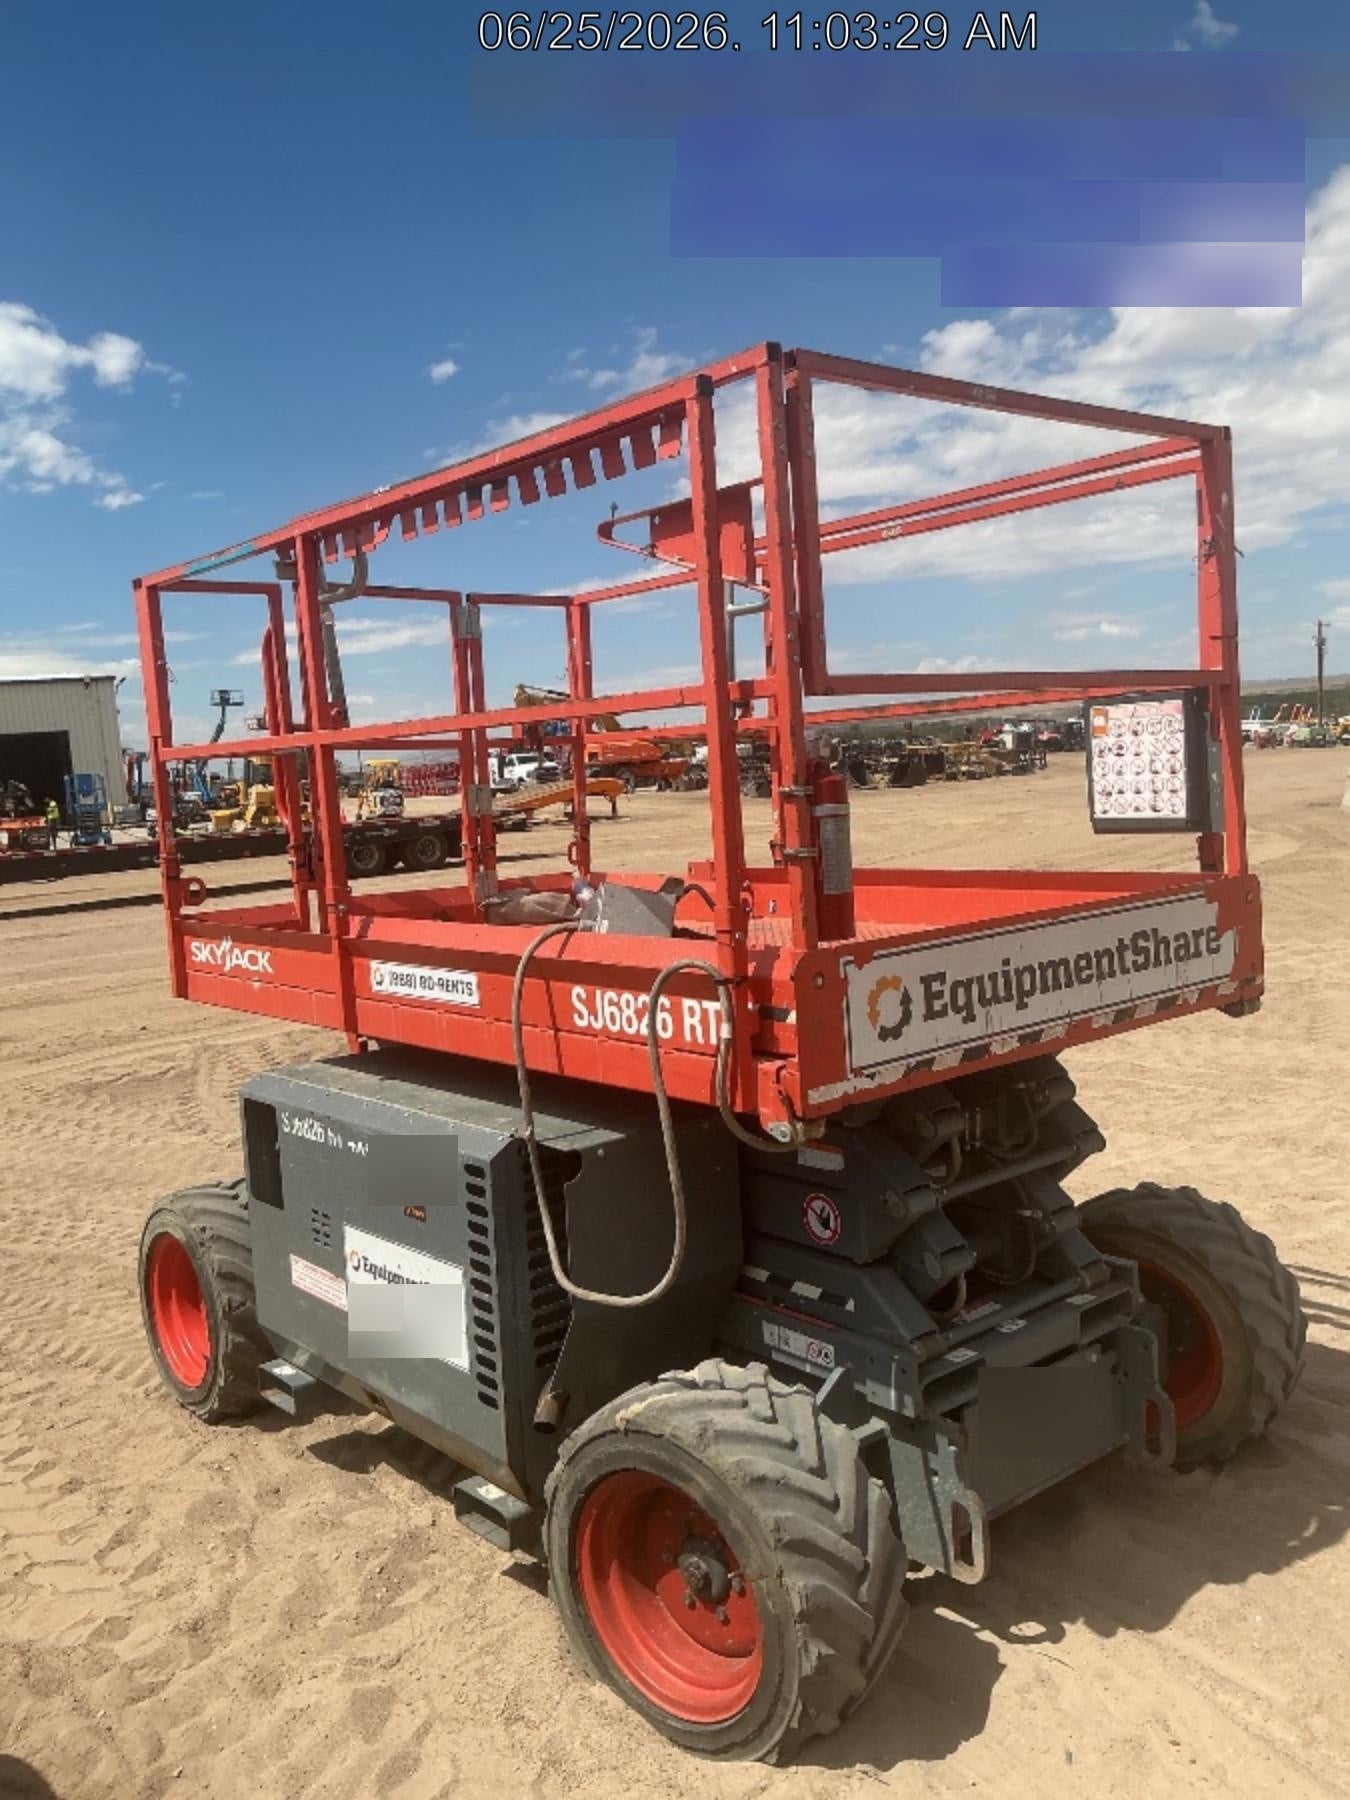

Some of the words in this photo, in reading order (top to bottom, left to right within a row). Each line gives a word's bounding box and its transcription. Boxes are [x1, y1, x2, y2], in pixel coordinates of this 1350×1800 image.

[190, 935, 274, 974] SKYJACK
[918, 924, 1222, 1024] EquipmentShare
[571, 985, 674, 1040] SJ6826
[681, 998, 721, 1046] RT
